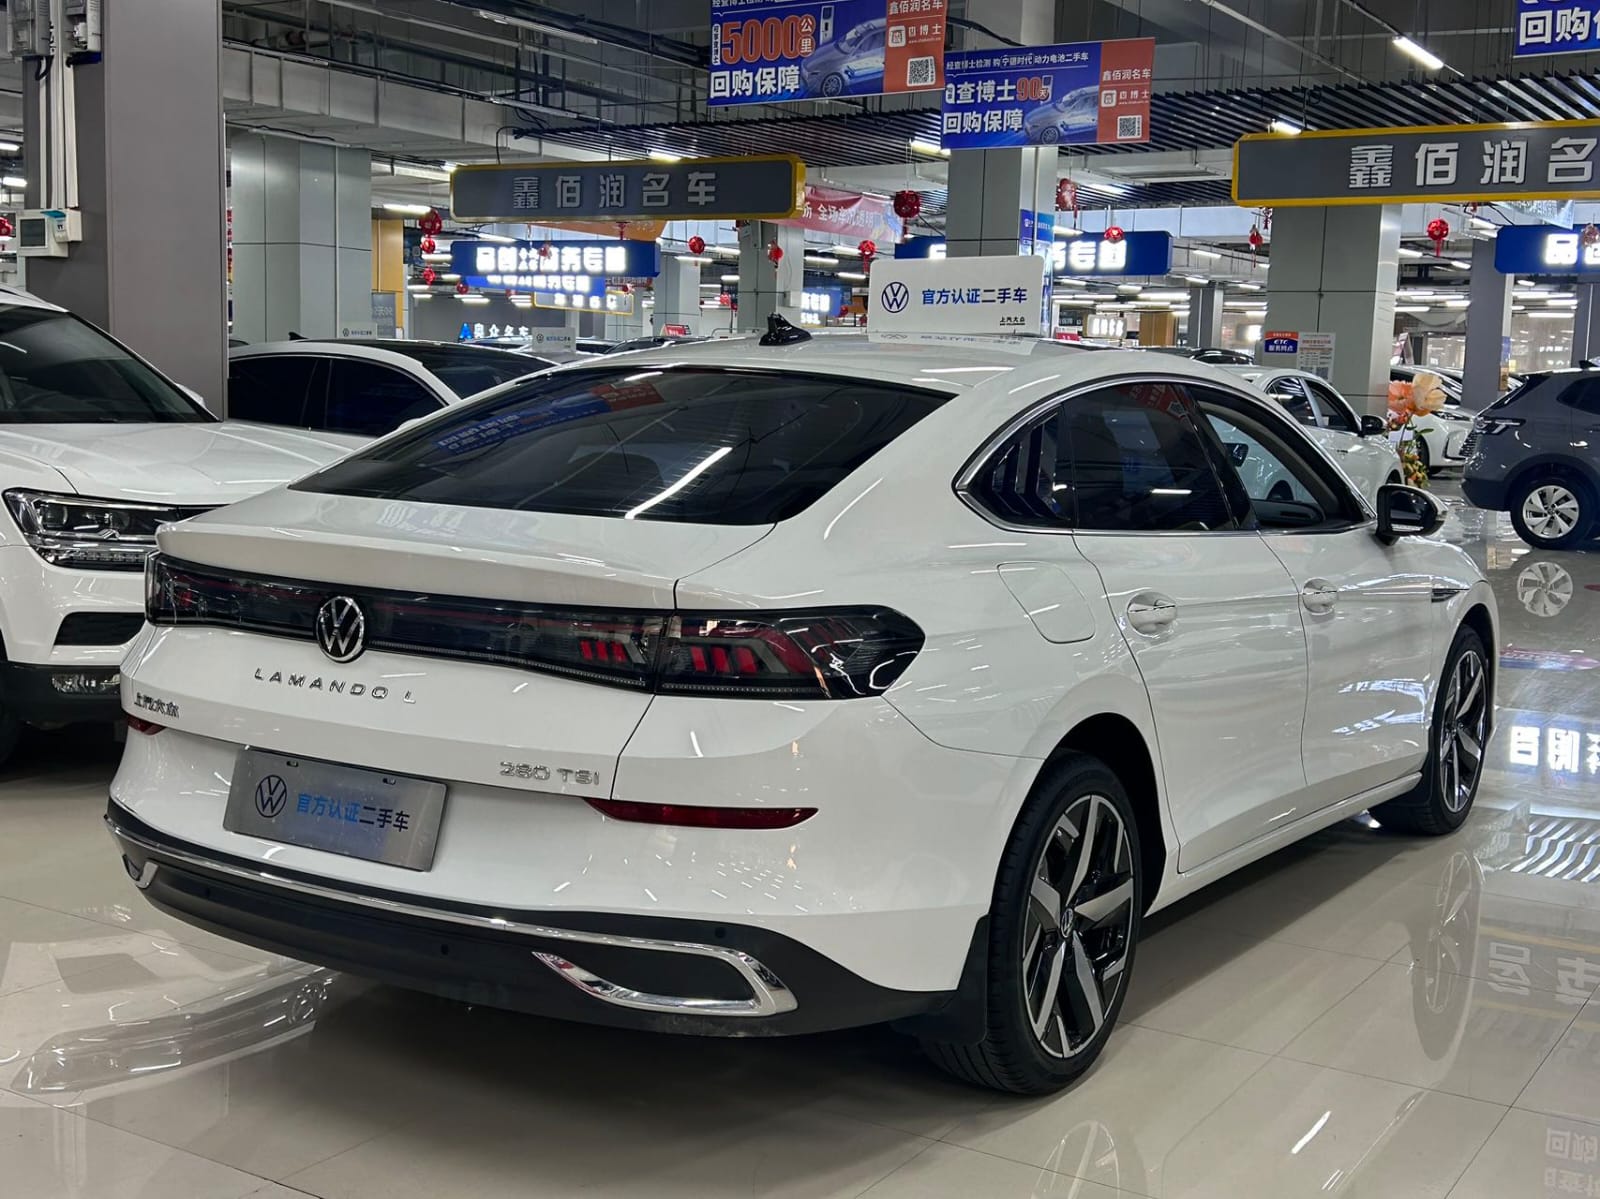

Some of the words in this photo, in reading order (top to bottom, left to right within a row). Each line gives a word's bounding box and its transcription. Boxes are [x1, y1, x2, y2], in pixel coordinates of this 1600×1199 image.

[1519, 7, 1600, 46] 回购
[710, 65, 800, 99] 回购保障
[943, 108, 1024, 135] 回购保障
[1348, 136, 1599, 189] 鑫佰润名
[512, 171, 717, 210] 鑫佰润名车
[921, 287, 1028, 305] 官方认证二手车
[254, 667, 389, 699] LAMANDO
[403, 690, 417, 704] L
[500, 761, 551, 781] 280
[556, 768, 600, 786] TSI
[296, 792, 411, 833] 官方认证二手车
